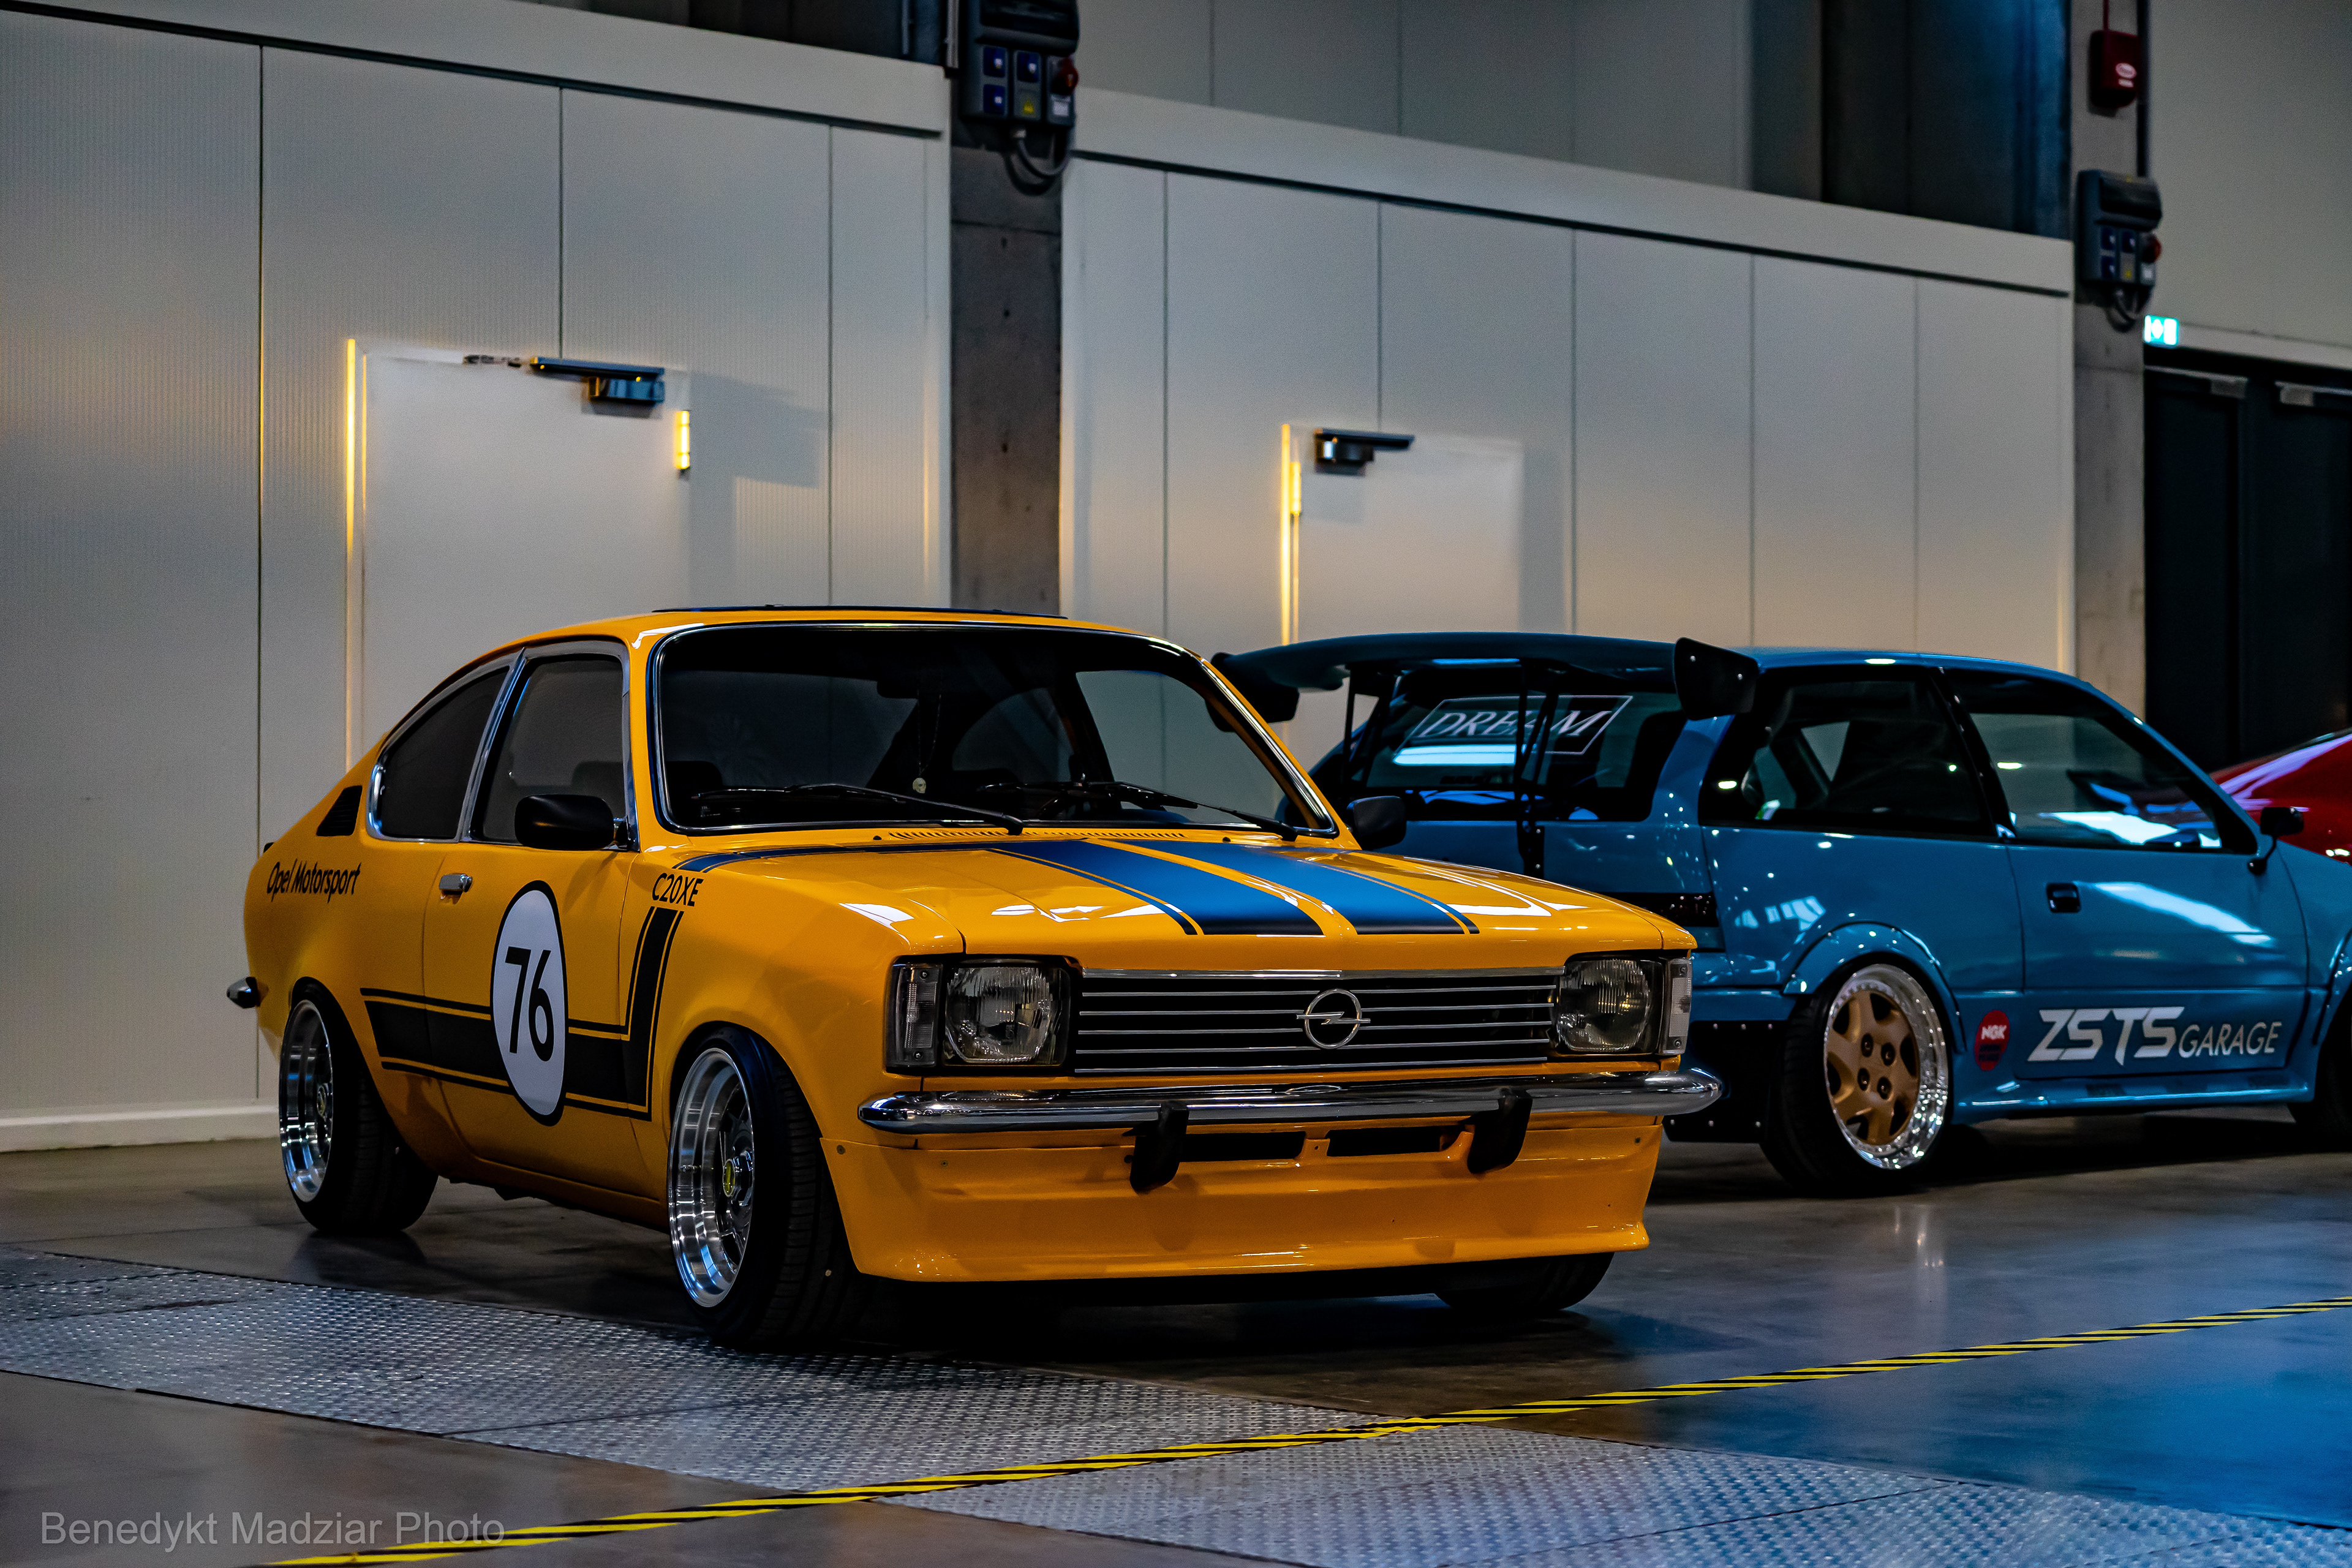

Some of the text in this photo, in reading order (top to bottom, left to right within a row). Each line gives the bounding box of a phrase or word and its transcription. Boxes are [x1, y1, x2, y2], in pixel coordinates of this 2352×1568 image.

[266, 858, 362, 903] Opel Motorsport
[652, 872, 704, 907] C20XE
[505, 946, 554, 1062] 76
[1980, 1024, 2007, 1040] NGK
[2027, 1006, 2283, 1066] ZSTS GARAGE
